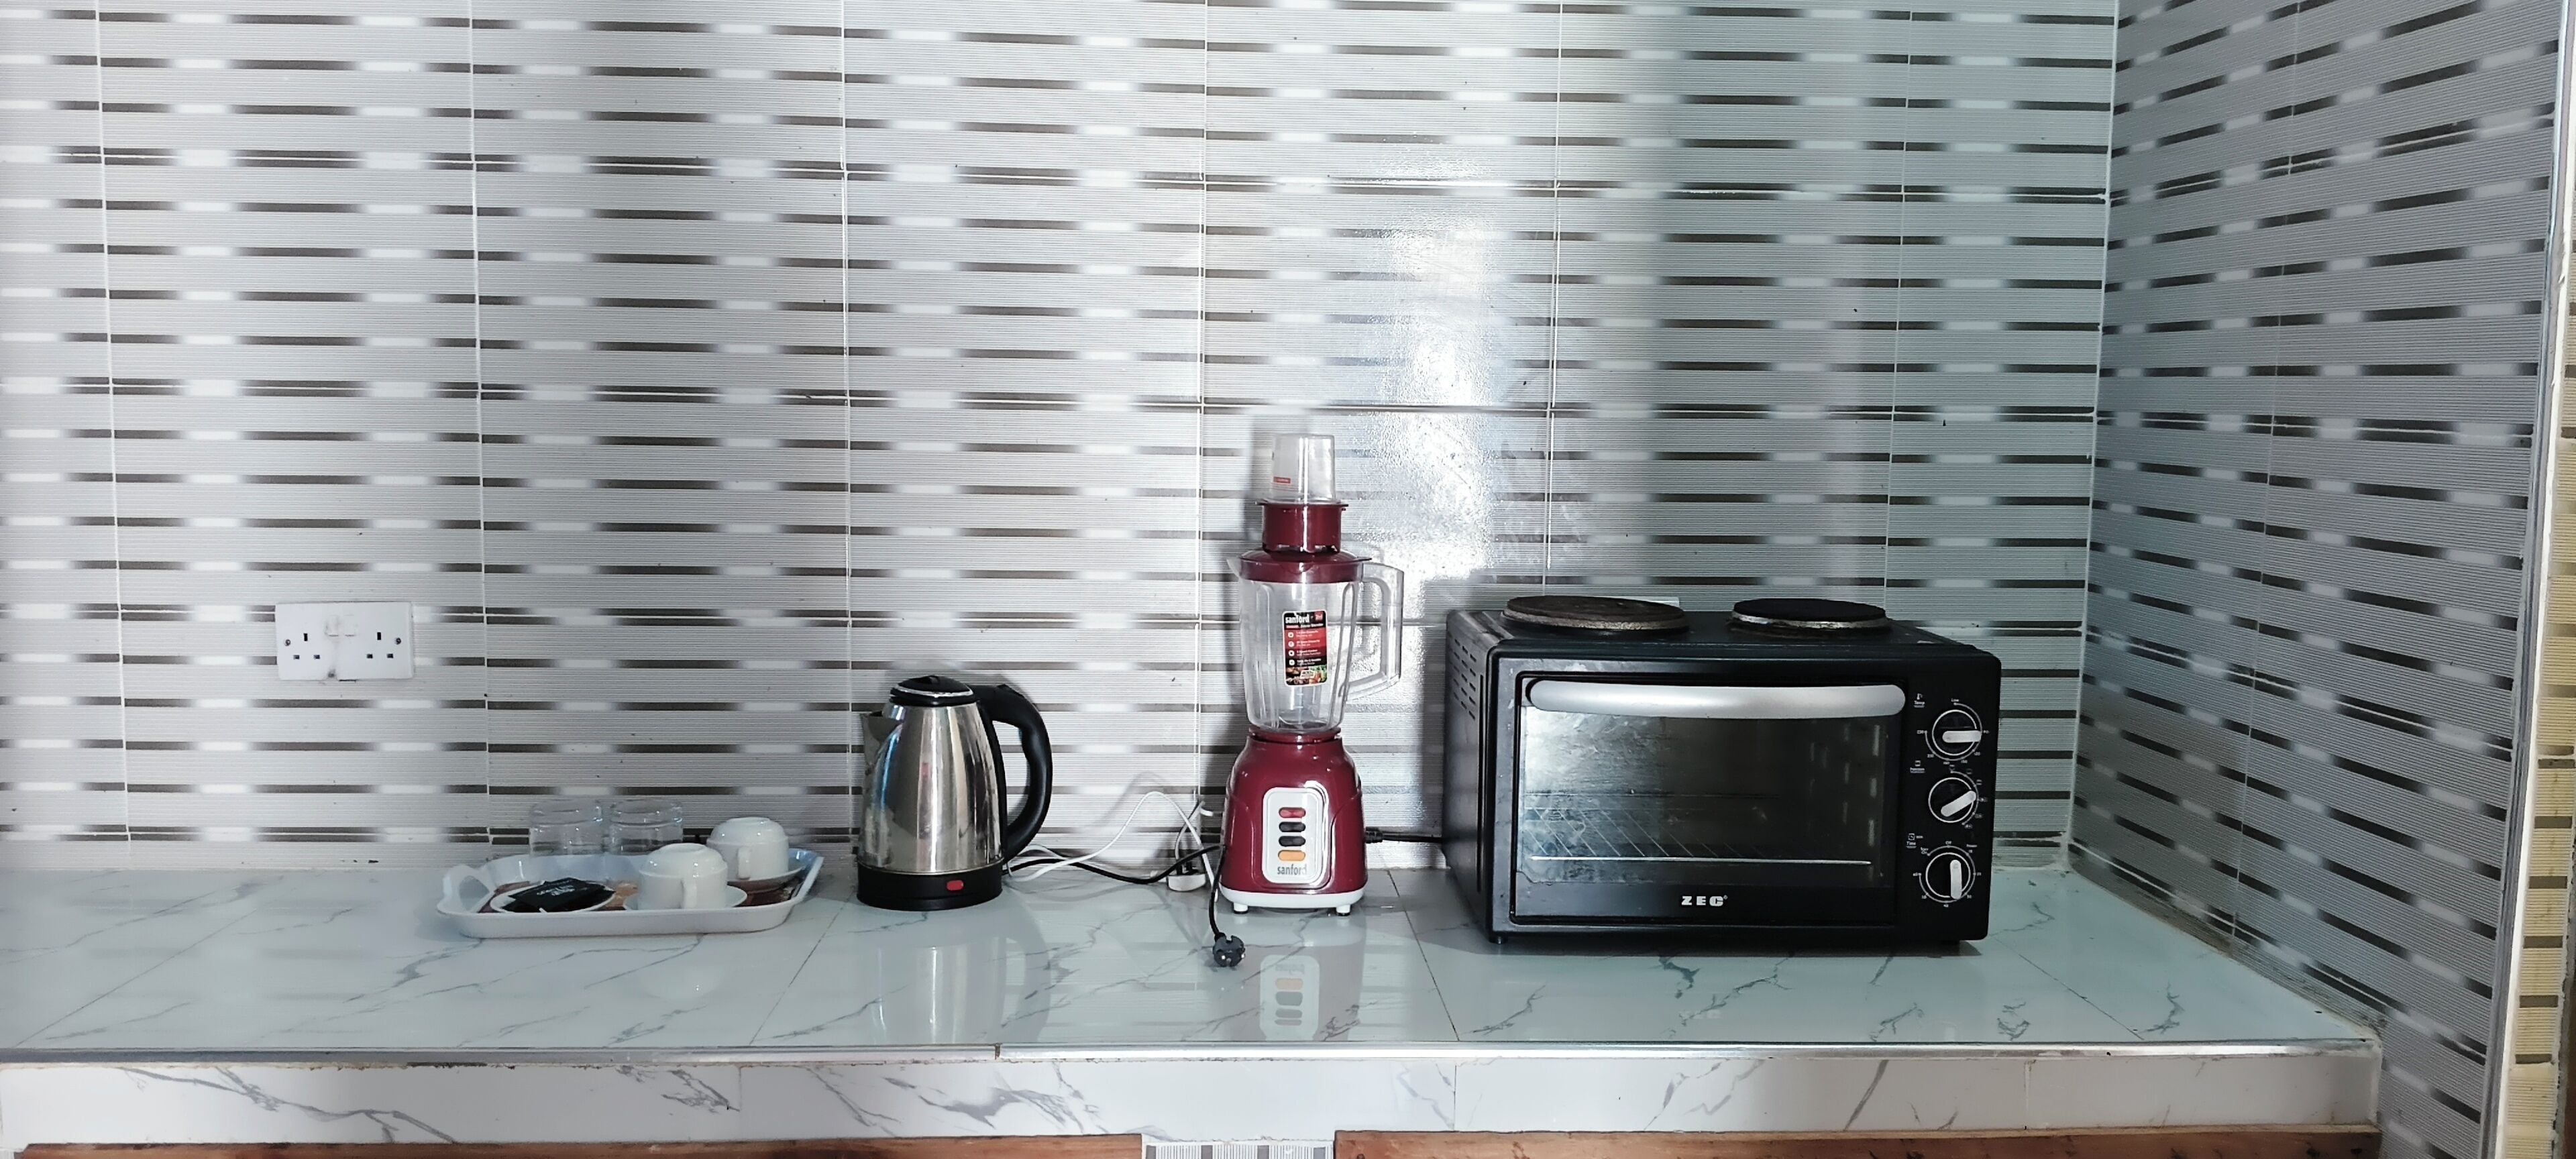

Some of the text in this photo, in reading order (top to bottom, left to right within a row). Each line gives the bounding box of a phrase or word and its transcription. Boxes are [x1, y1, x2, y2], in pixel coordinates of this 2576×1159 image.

[1285, 613, 1310, 624] sanford
[1277, 863, 1307, 875] sanford
[1681, 895, 1724, 907] ZEC
